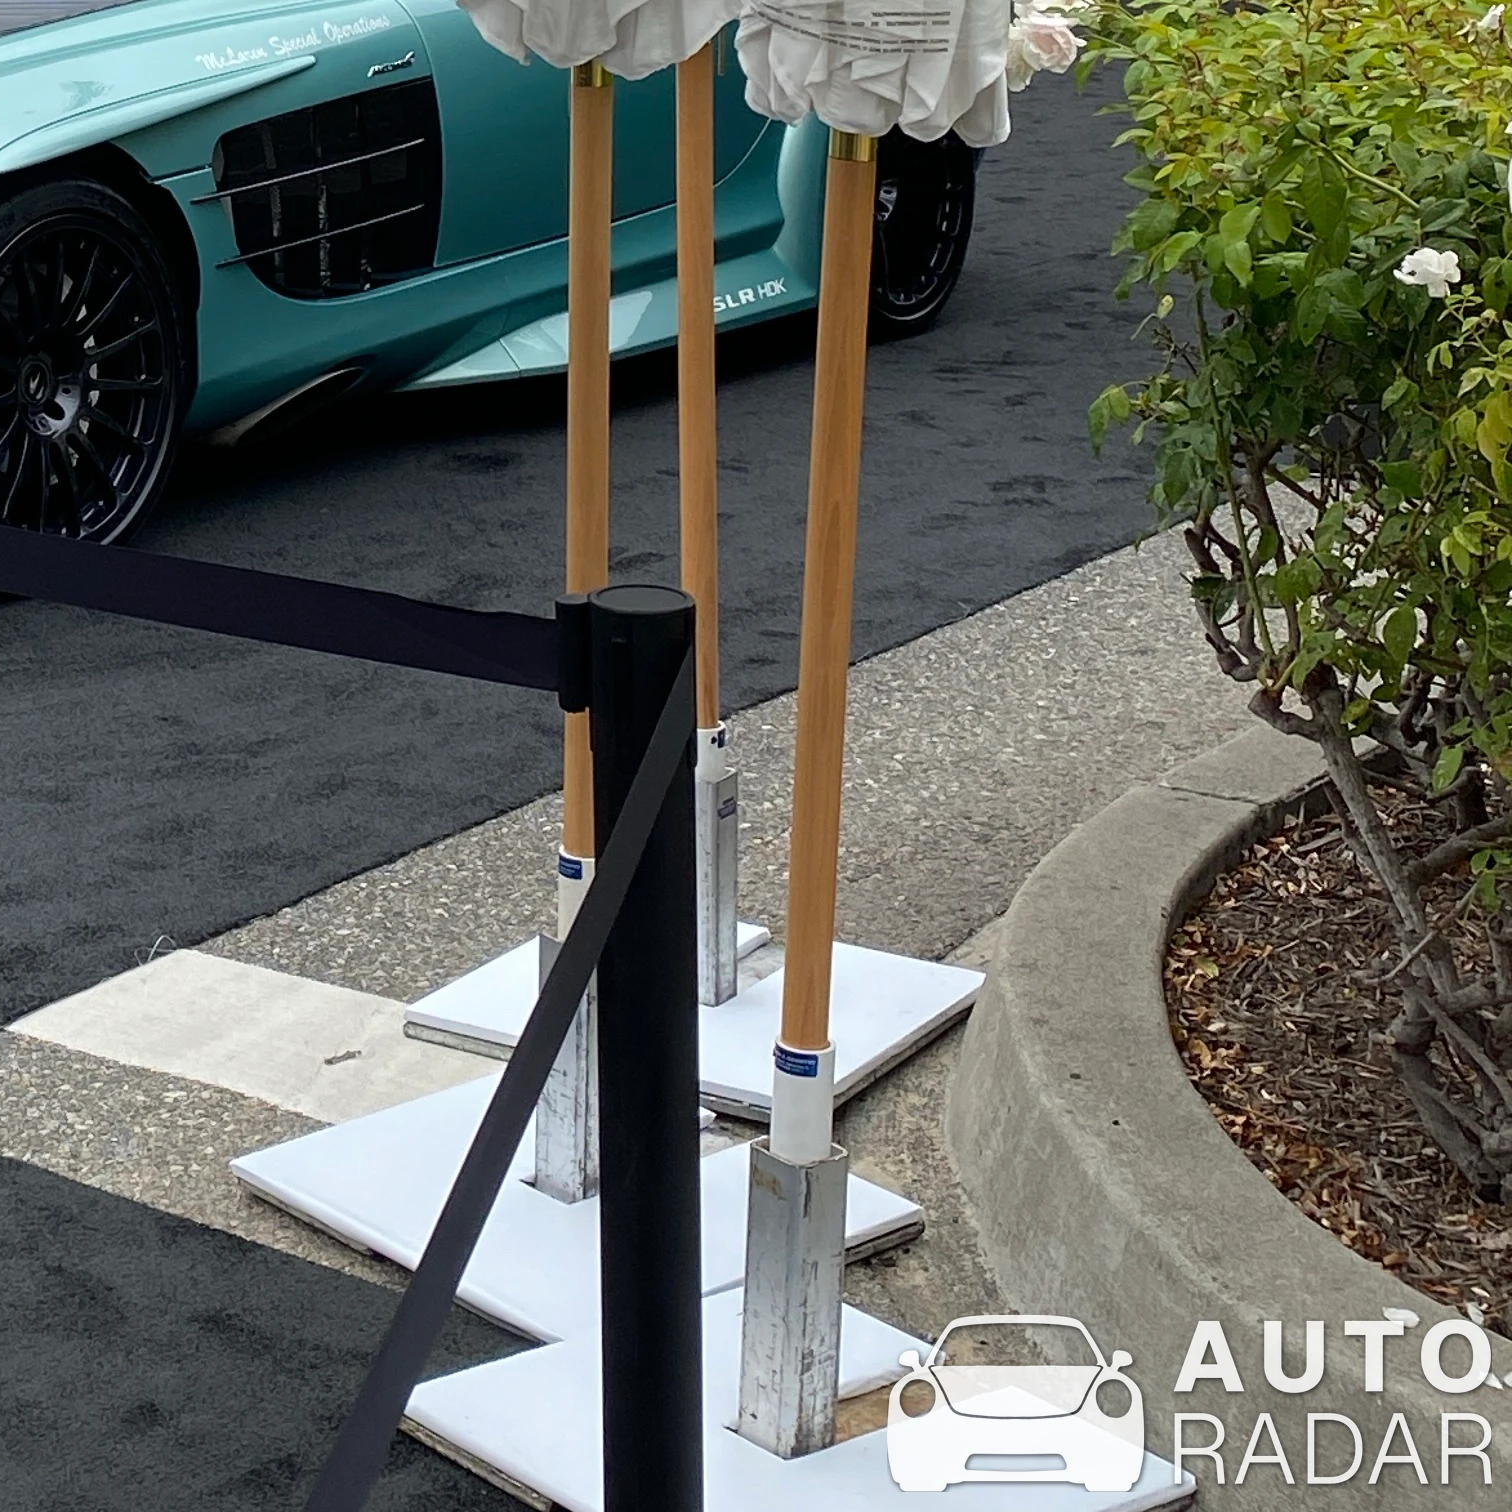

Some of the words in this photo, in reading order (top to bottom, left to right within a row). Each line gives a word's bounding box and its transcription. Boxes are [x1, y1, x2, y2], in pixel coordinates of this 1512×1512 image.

[195, 46, 268, 71] McLaren
[268, 27, 322, 56] Special
[322, 14, 391, 44] Operations
[713, 287, 756, 313] SLR
[756, 276, 787, 300] HDK
